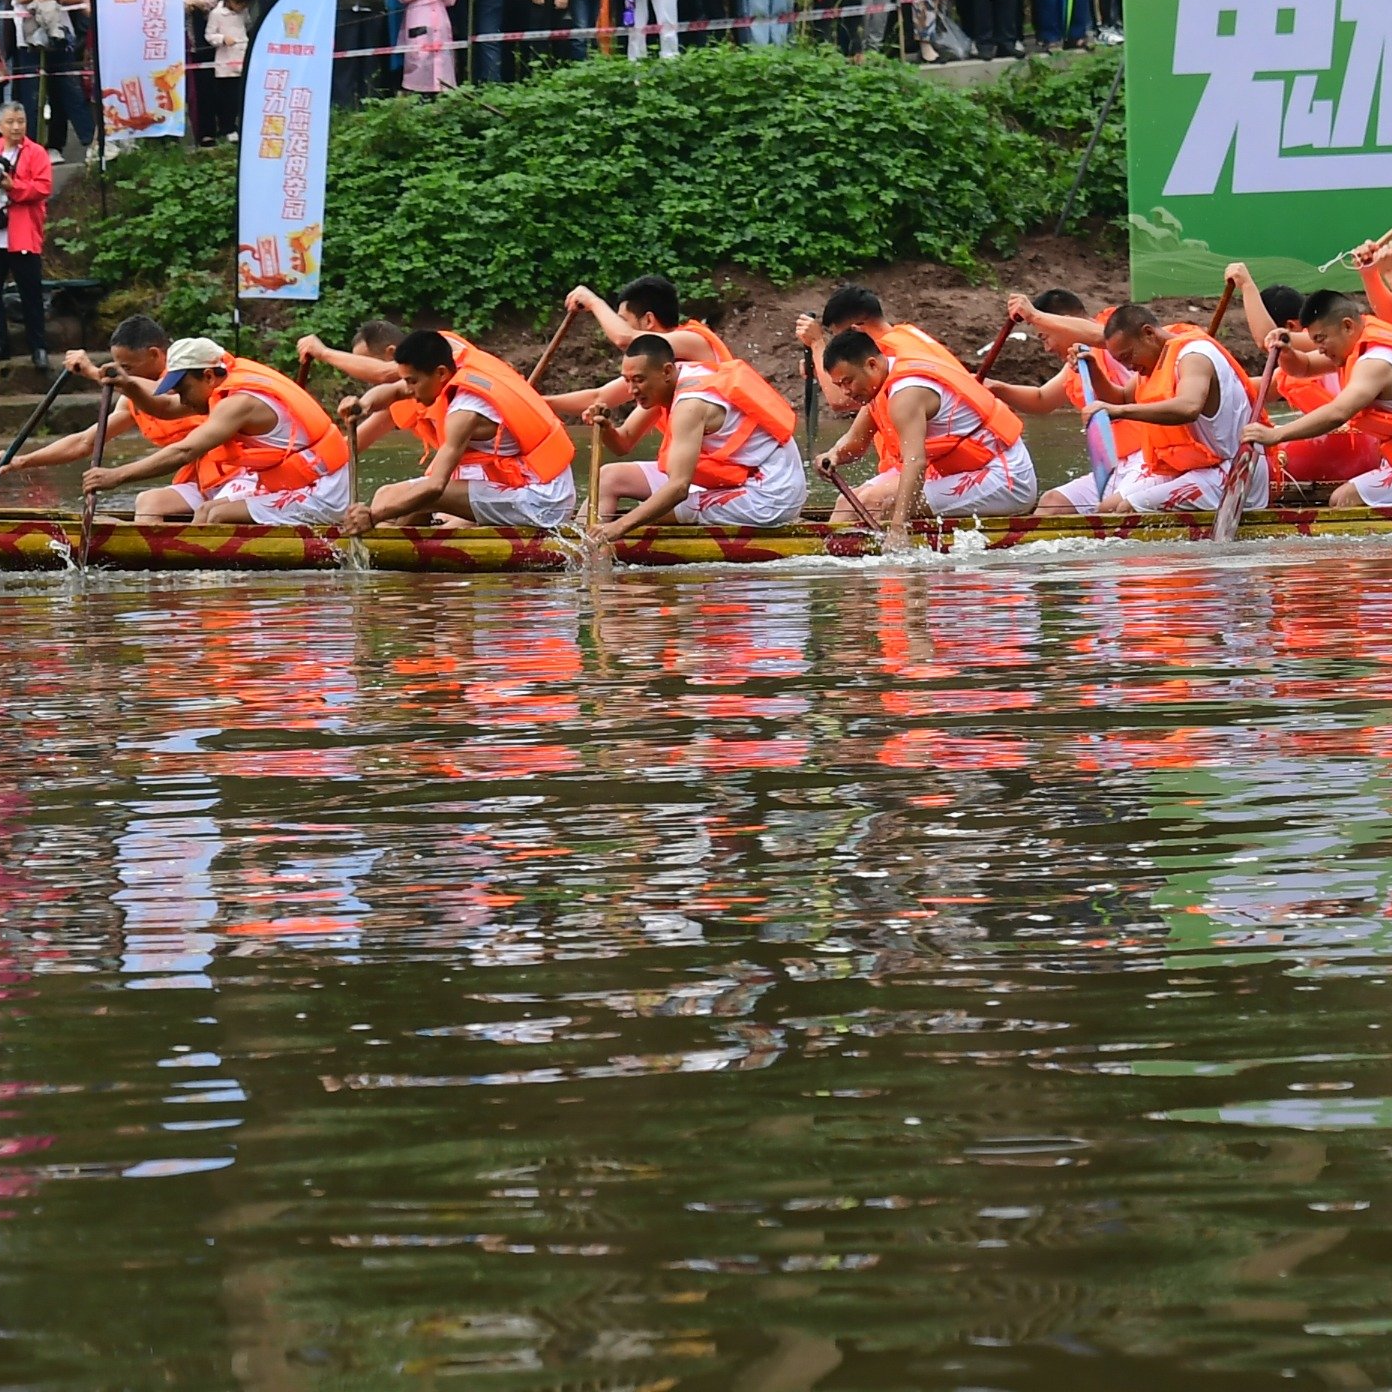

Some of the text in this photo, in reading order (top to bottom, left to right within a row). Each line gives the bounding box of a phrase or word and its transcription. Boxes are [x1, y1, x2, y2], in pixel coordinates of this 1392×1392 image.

[282, 87, 311, 220] 助您龙舟夺冠
